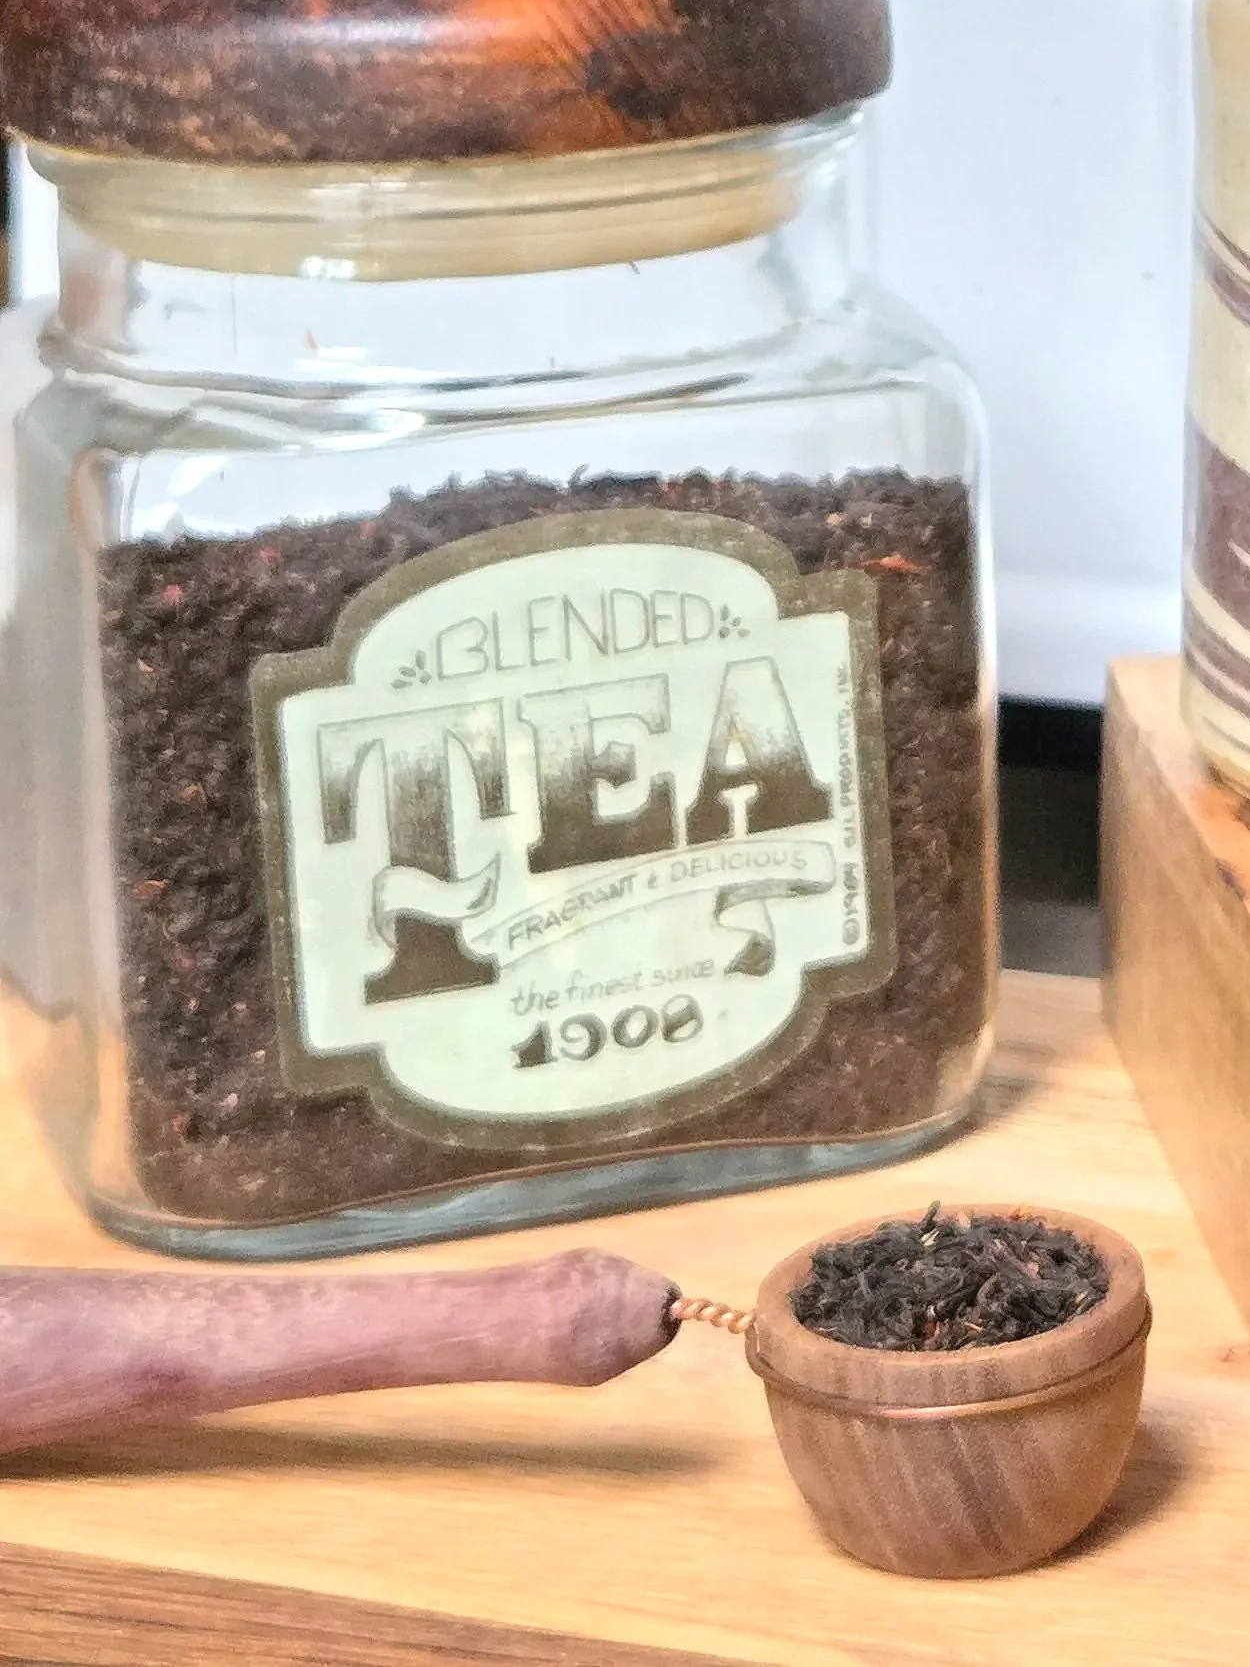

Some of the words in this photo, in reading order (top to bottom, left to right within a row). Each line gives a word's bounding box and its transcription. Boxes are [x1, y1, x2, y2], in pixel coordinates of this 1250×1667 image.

[435, 588, 714, 681] BLENDED
[317, 655, 834, 1005] TEA
[507, 874, 637, 950] FRAGRANT
[670, 849, 809, 883] DELICIOUS
[510, 985, 559, 1016] the
[564, 968, 645, 1004] finest
